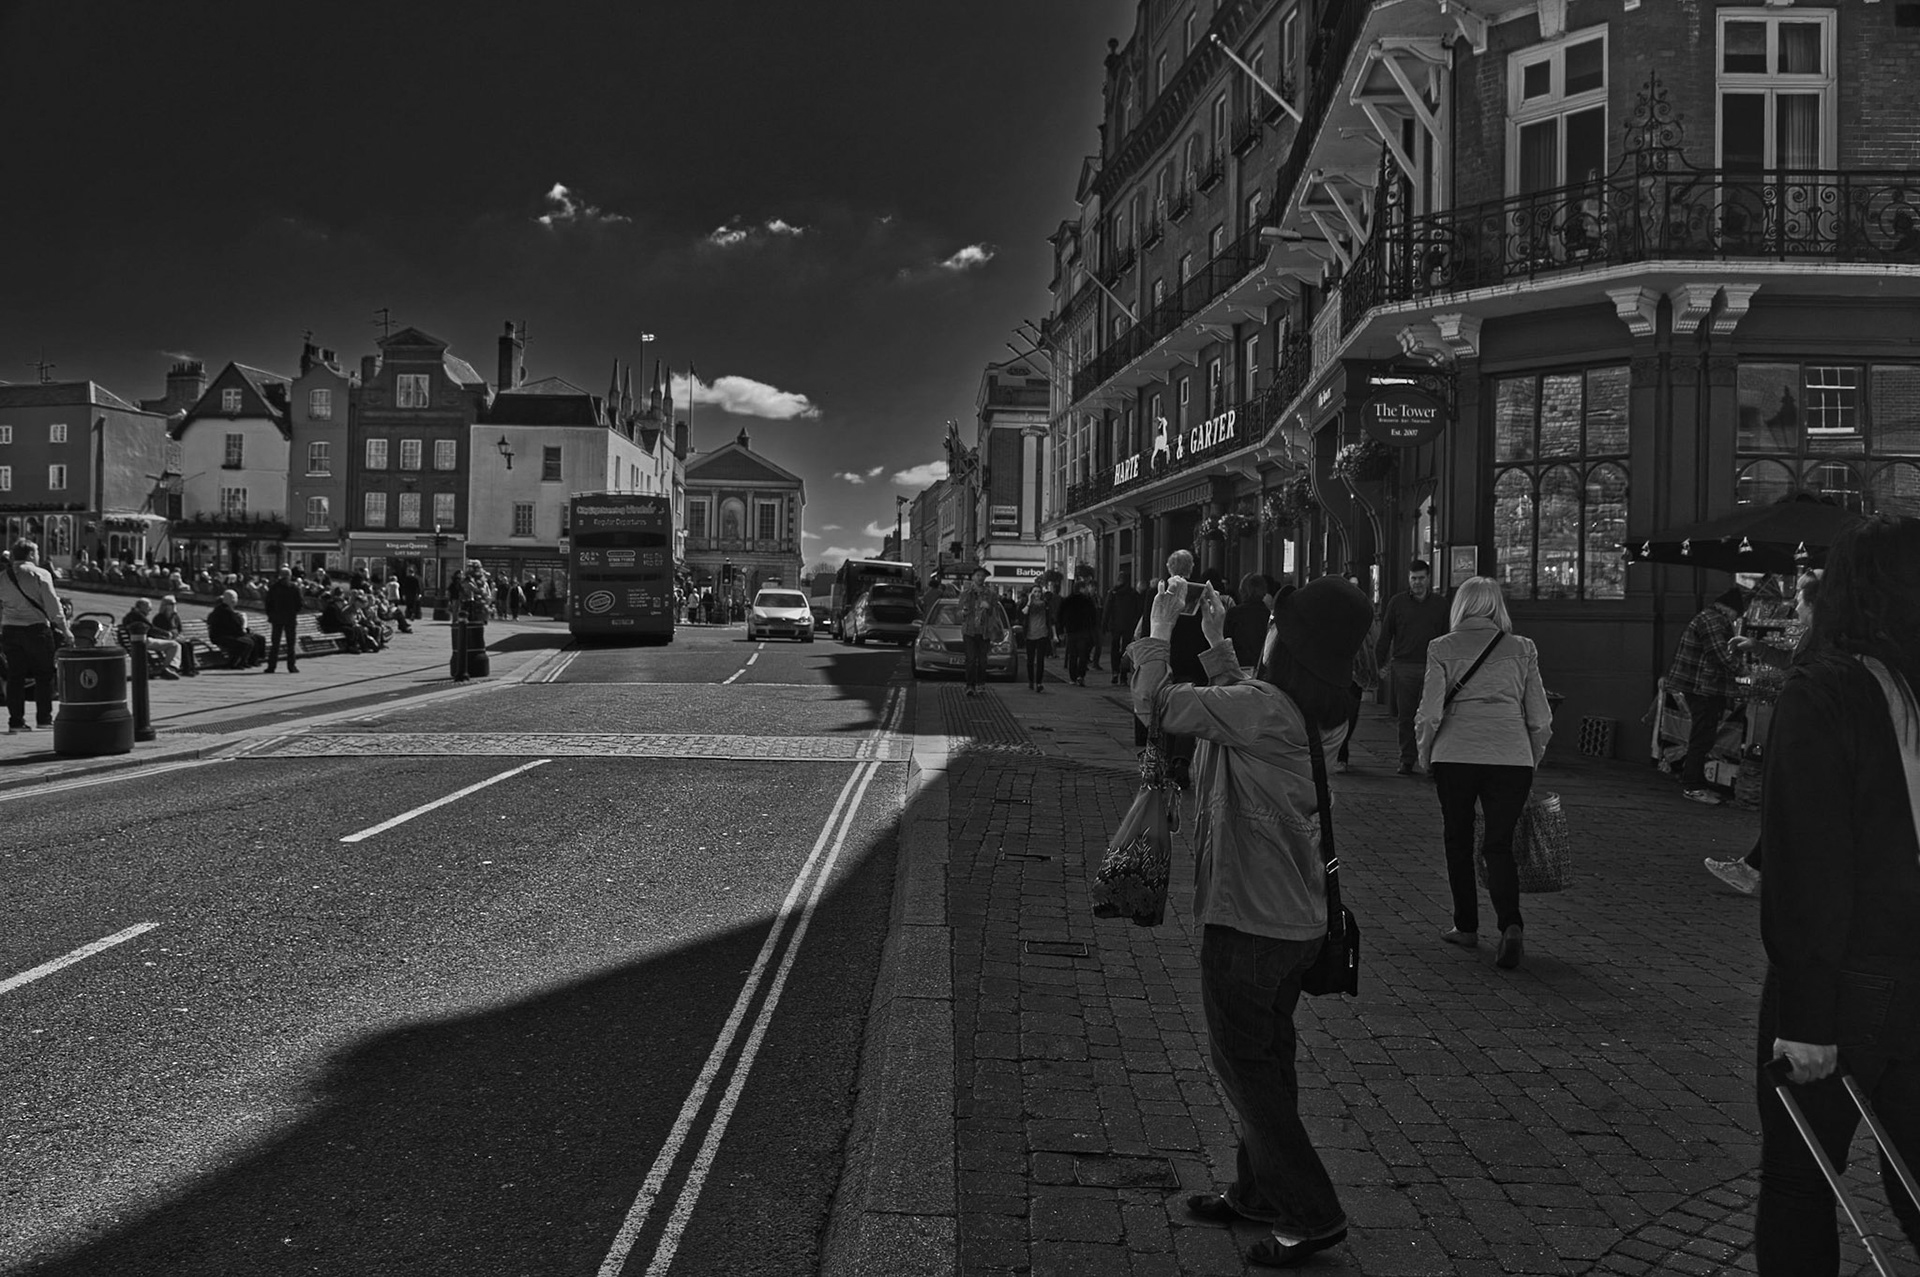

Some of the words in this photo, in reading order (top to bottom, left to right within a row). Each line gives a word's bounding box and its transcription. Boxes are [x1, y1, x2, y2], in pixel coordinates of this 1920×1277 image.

[1374, 403, 1398, 417] The
[1399, 404, 1437, 418] Tower
[1391, 428, 1402, 436] Est.
[1403, 428, 1418, 436] 2007
[1114, 454, 1140, 486] HARTE
[1177, 434, 1183, 460] &
[1190, 410, 1236, 454] GARTER
